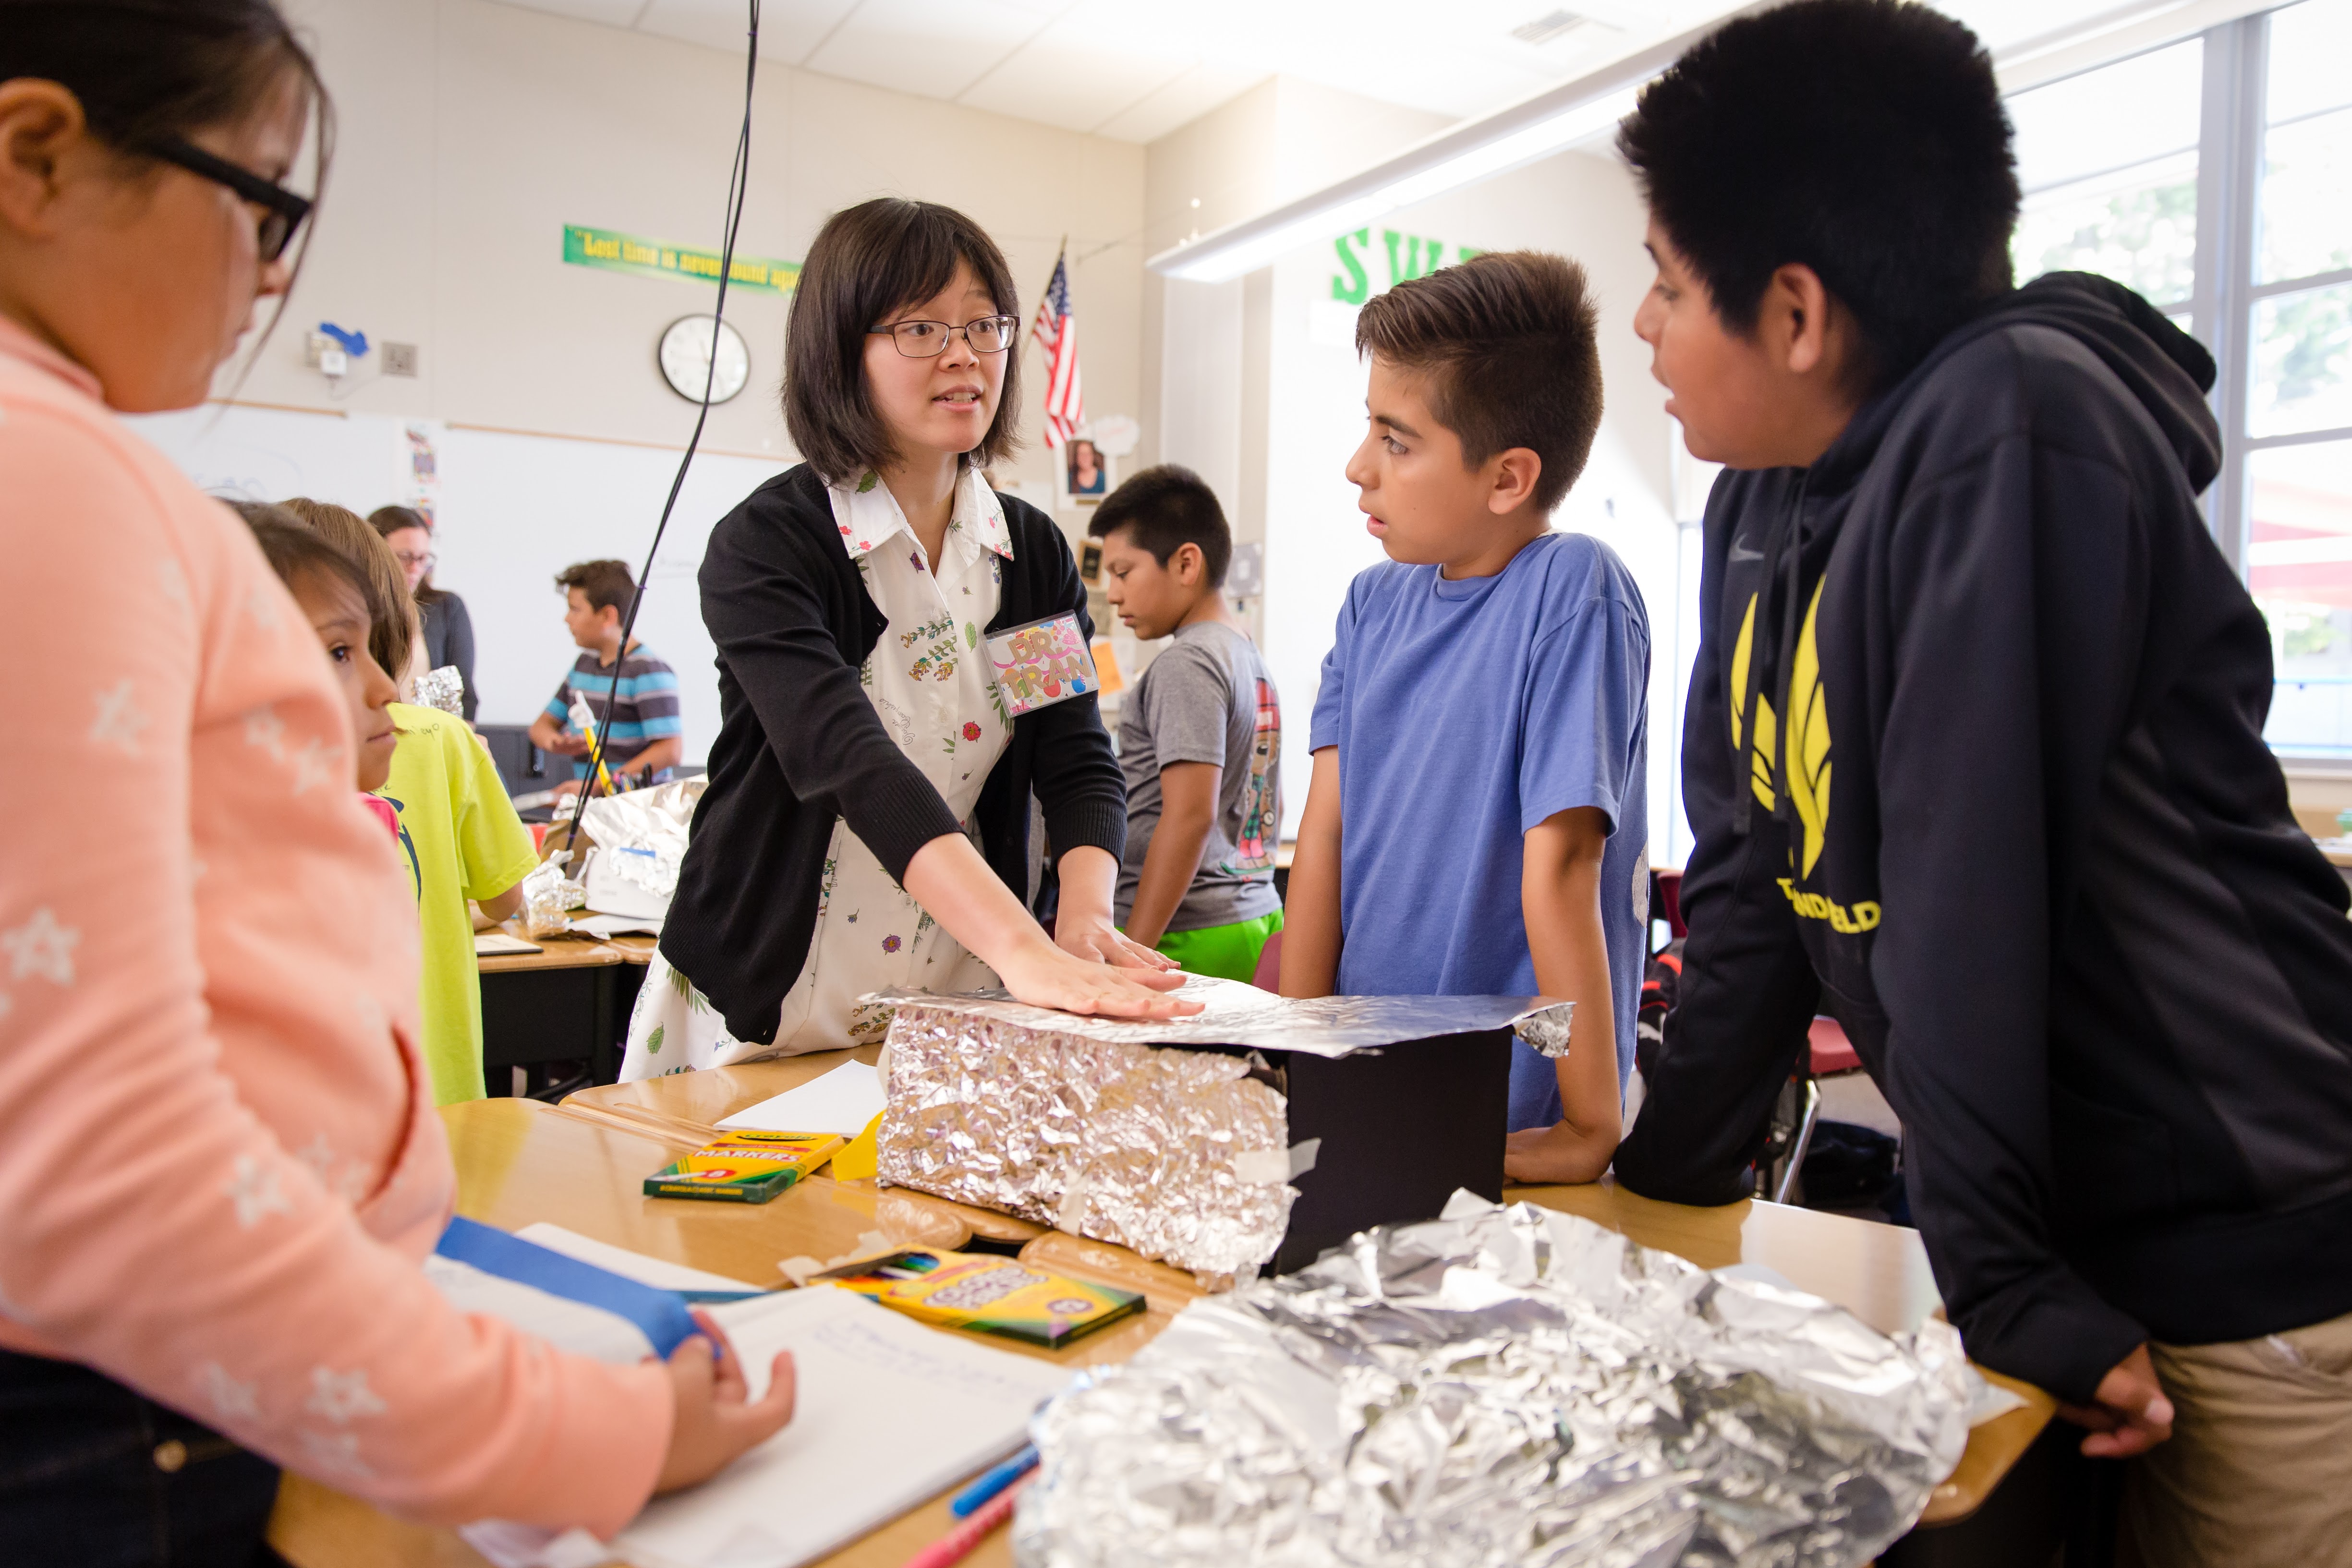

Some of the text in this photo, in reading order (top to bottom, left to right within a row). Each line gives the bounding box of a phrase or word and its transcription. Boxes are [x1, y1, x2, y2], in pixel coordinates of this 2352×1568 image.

[1332, 227, 1486, 305] SW
[1007, 632, 1063, 665] DR.
[999, 653, 1092, 699] TRAN
[693, 1150, 801, 1162] MARKERS
